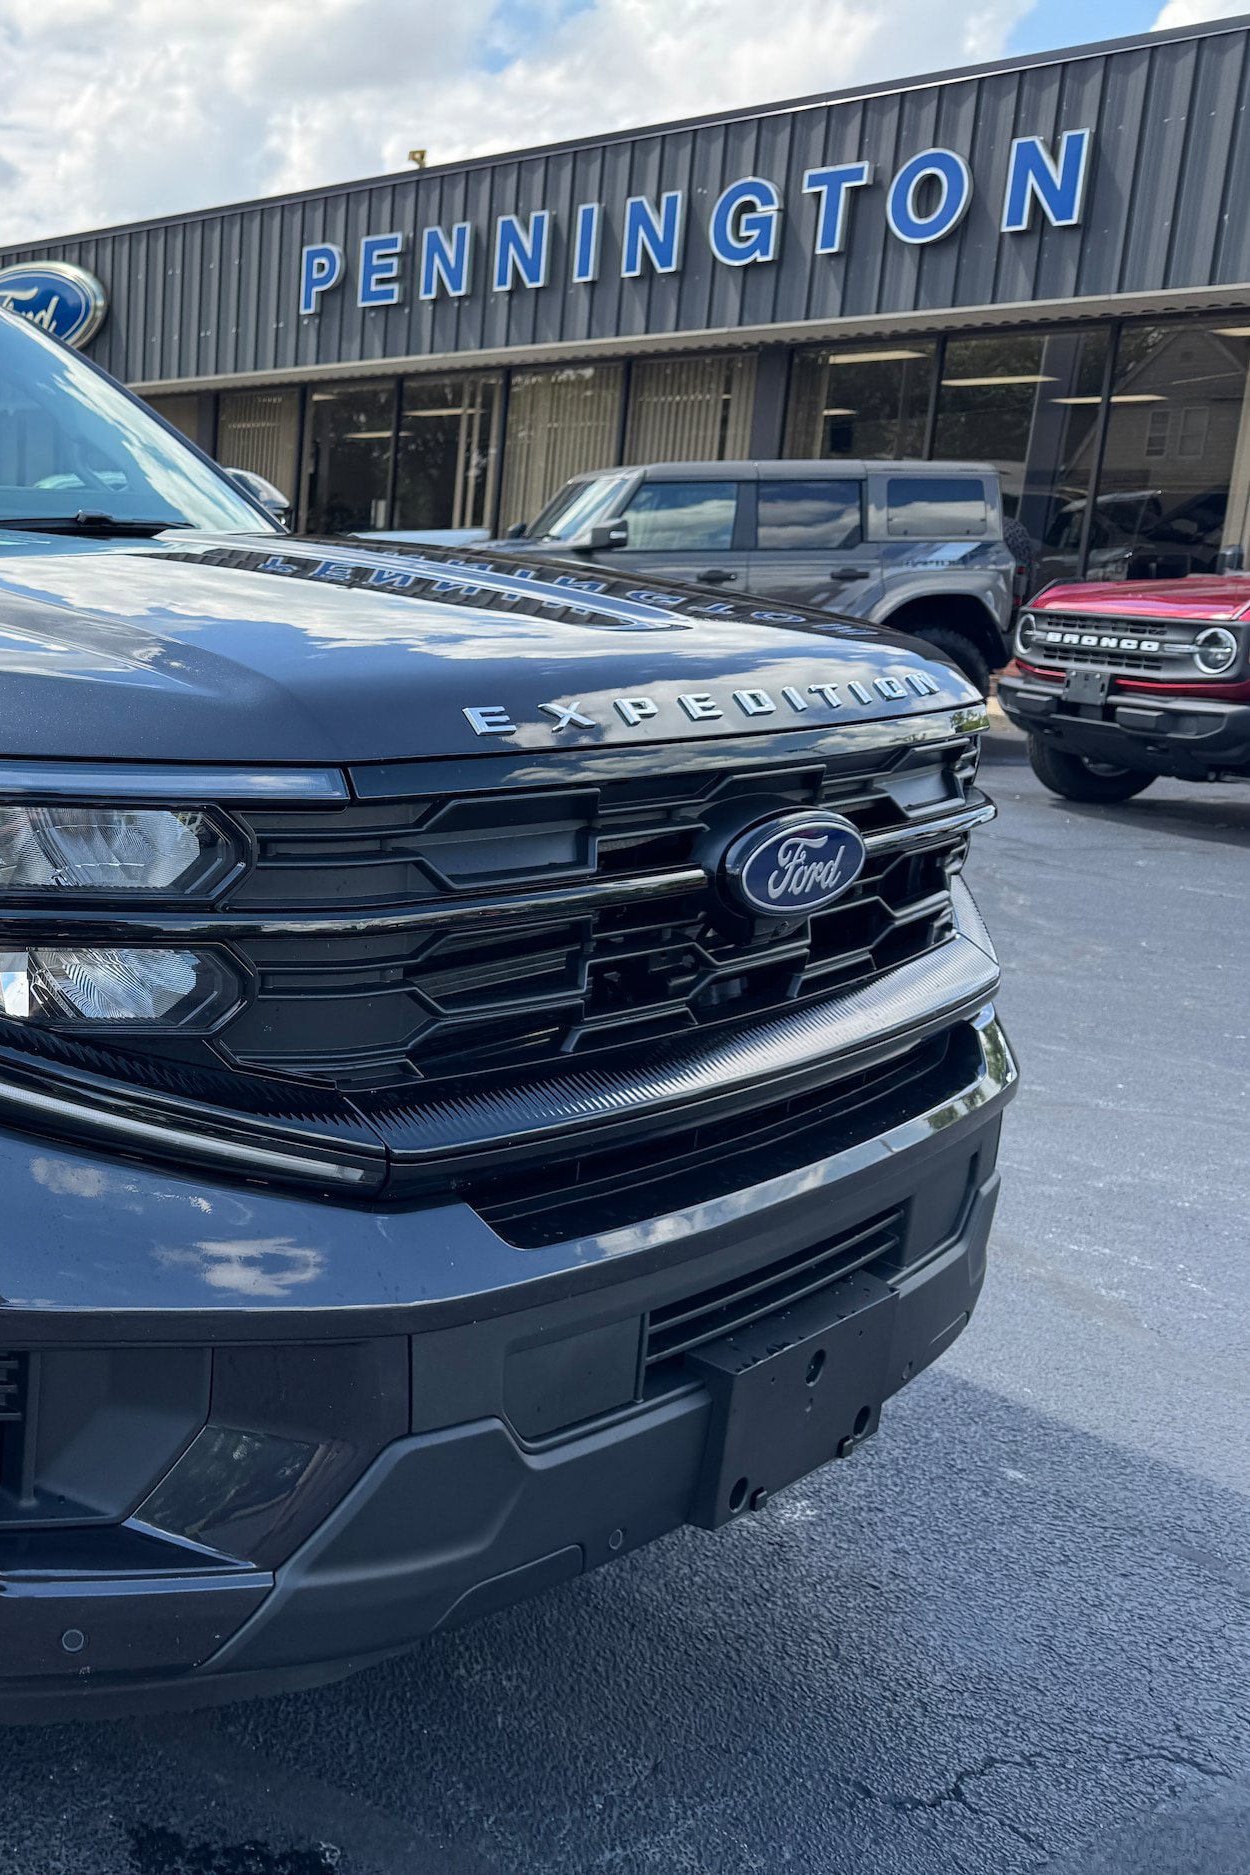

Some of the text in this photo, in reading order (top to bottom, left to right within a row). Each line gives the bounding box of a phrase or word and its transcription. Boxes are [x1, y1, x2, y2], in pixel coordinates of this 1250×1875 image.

[298, 127, 1092, 316] PENNINGTON
[1046, 631, 1160, 652] BRONCO
[461, 671, 941, 738] EXPEDITION
[768, 835, 846, 899] Ford
